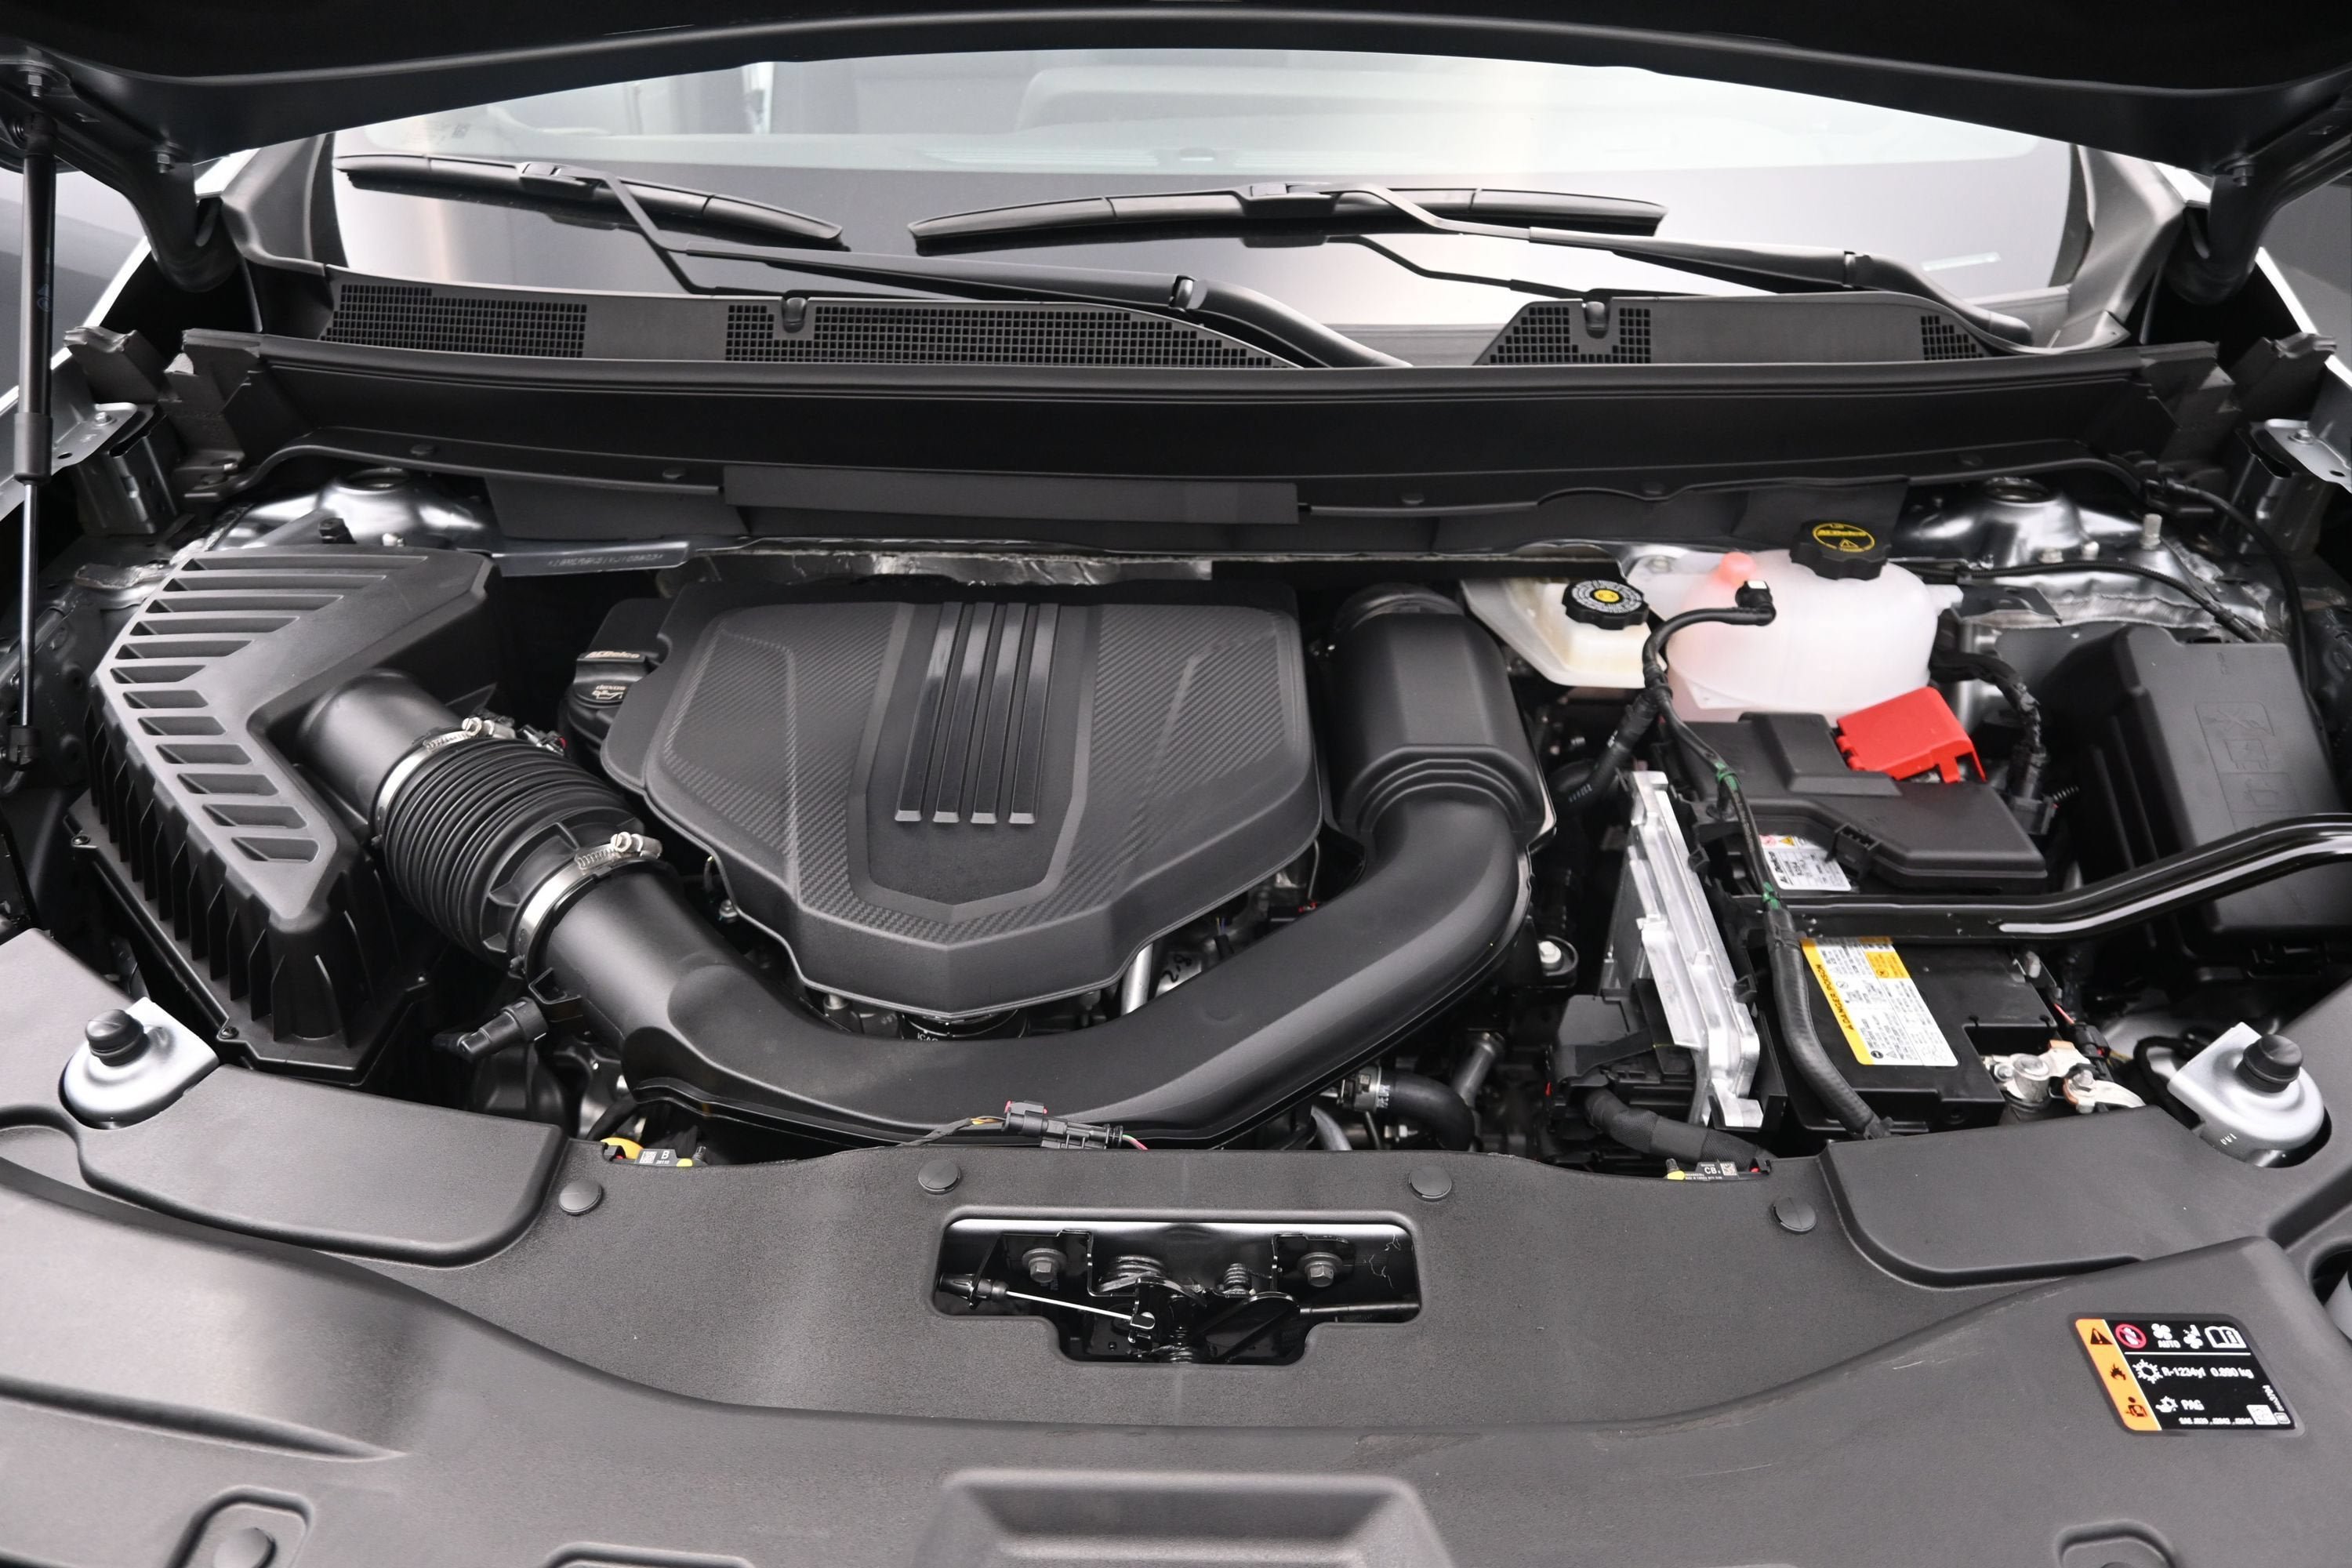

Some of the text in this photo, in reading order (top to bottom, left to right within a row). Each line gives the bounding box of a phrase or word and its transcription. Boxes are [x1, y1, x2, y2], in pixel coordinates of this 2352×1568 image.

[1815, 964, 1832, 991] POISON
[1829, 993, 1850, 1024] DANGER
[661, 1150, 670, 1160] B
[2158, 1340, 2181, 1348] AUTO
[2238, 1367, 2255, 1379] kg
[2180, 1399, 2205, 1410] PAG
